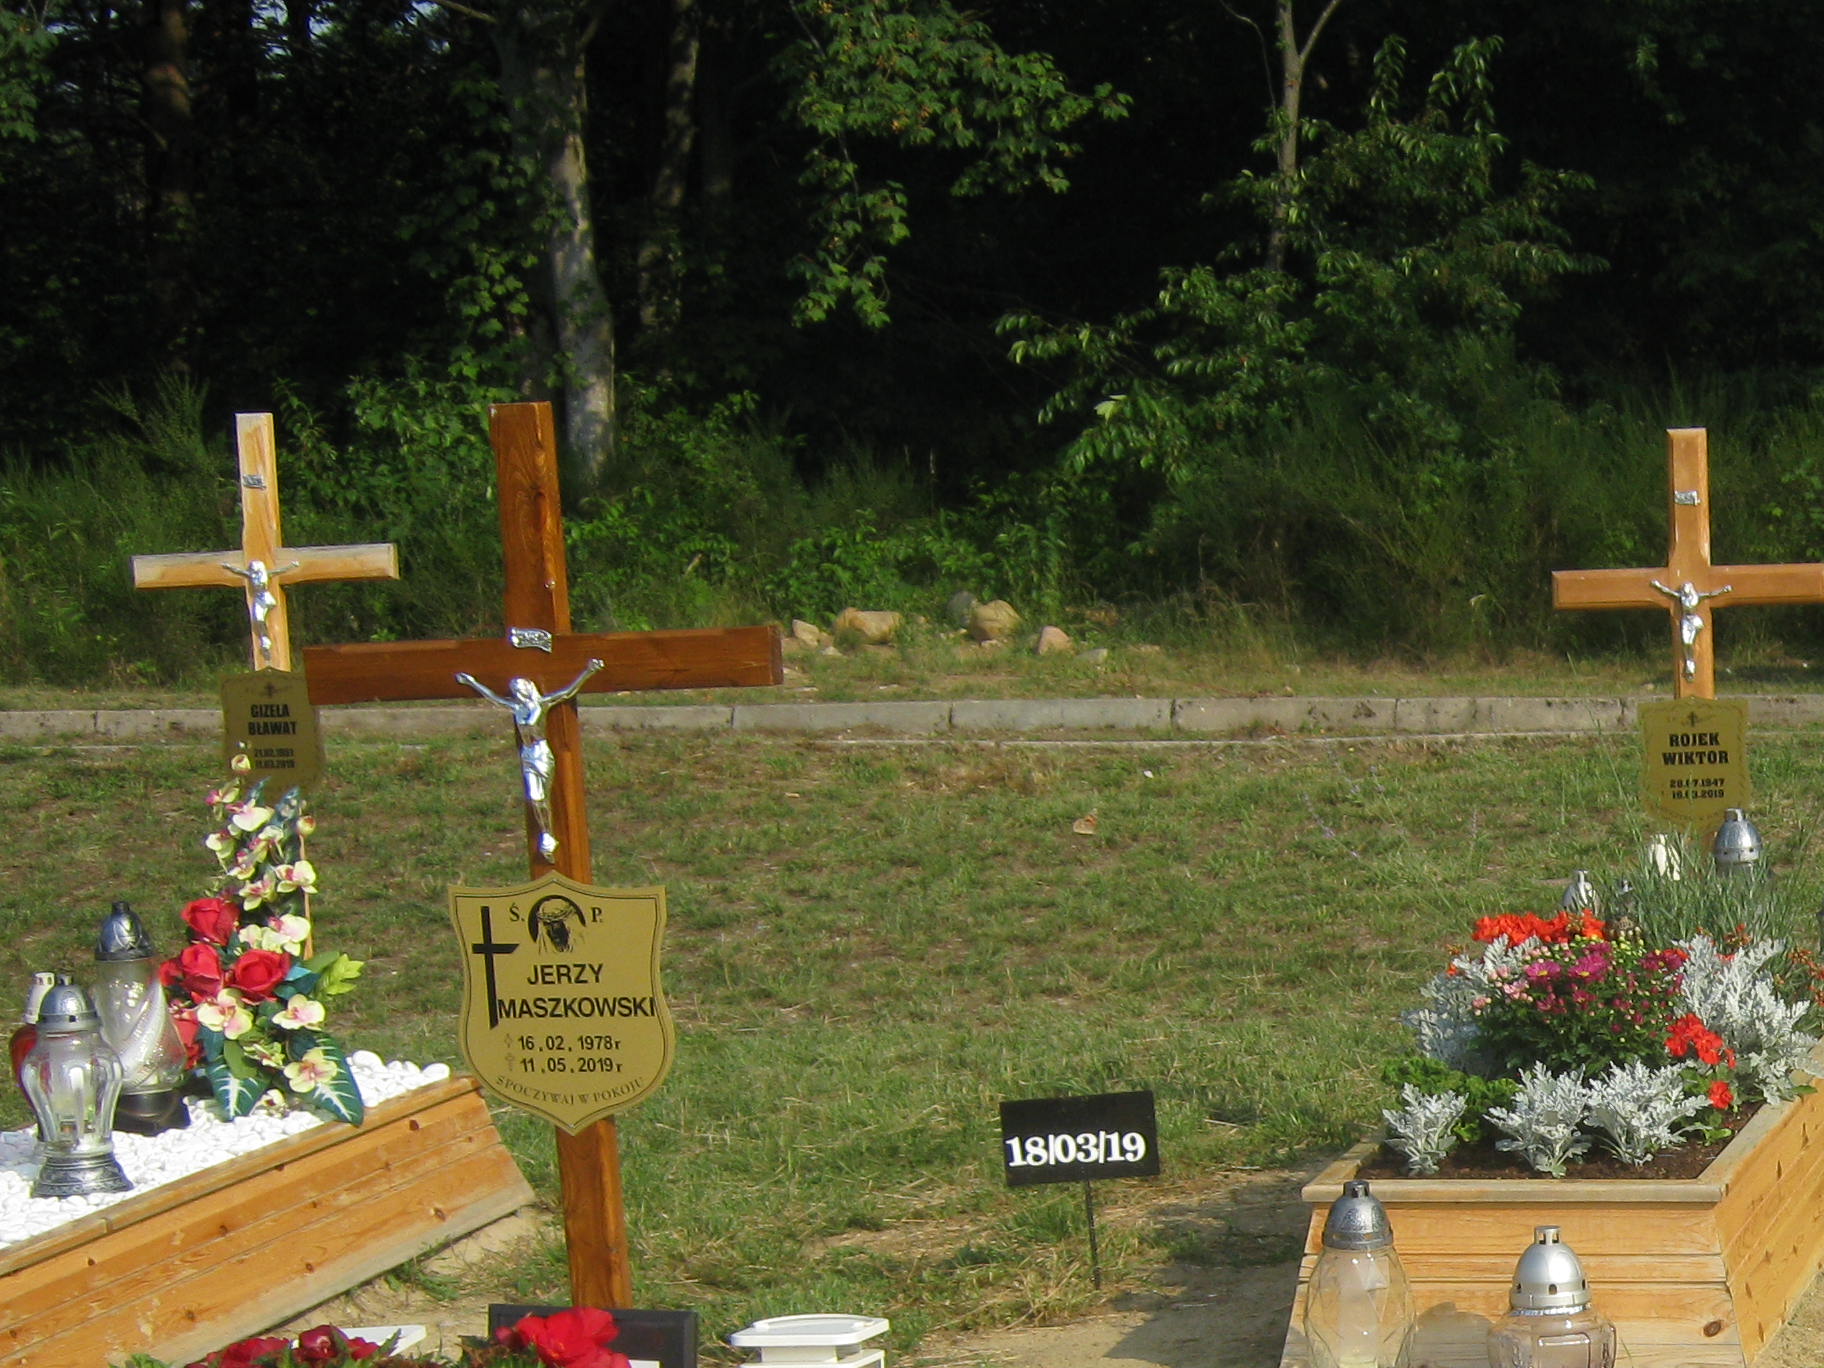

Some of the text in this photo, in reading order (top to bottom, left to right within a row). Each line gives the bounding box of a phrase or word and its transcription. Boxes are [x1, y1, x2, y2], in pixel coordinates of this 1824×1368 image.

[250, 704, 290, 718] GIZELA
[1669, 732, 1720, 747] ROJEK
[1662, 750, 1729, 765] WIKTOR
[527, 964, 604, 985] JERZY
[499, 997, 656, 1019] MASZKOWSKI
